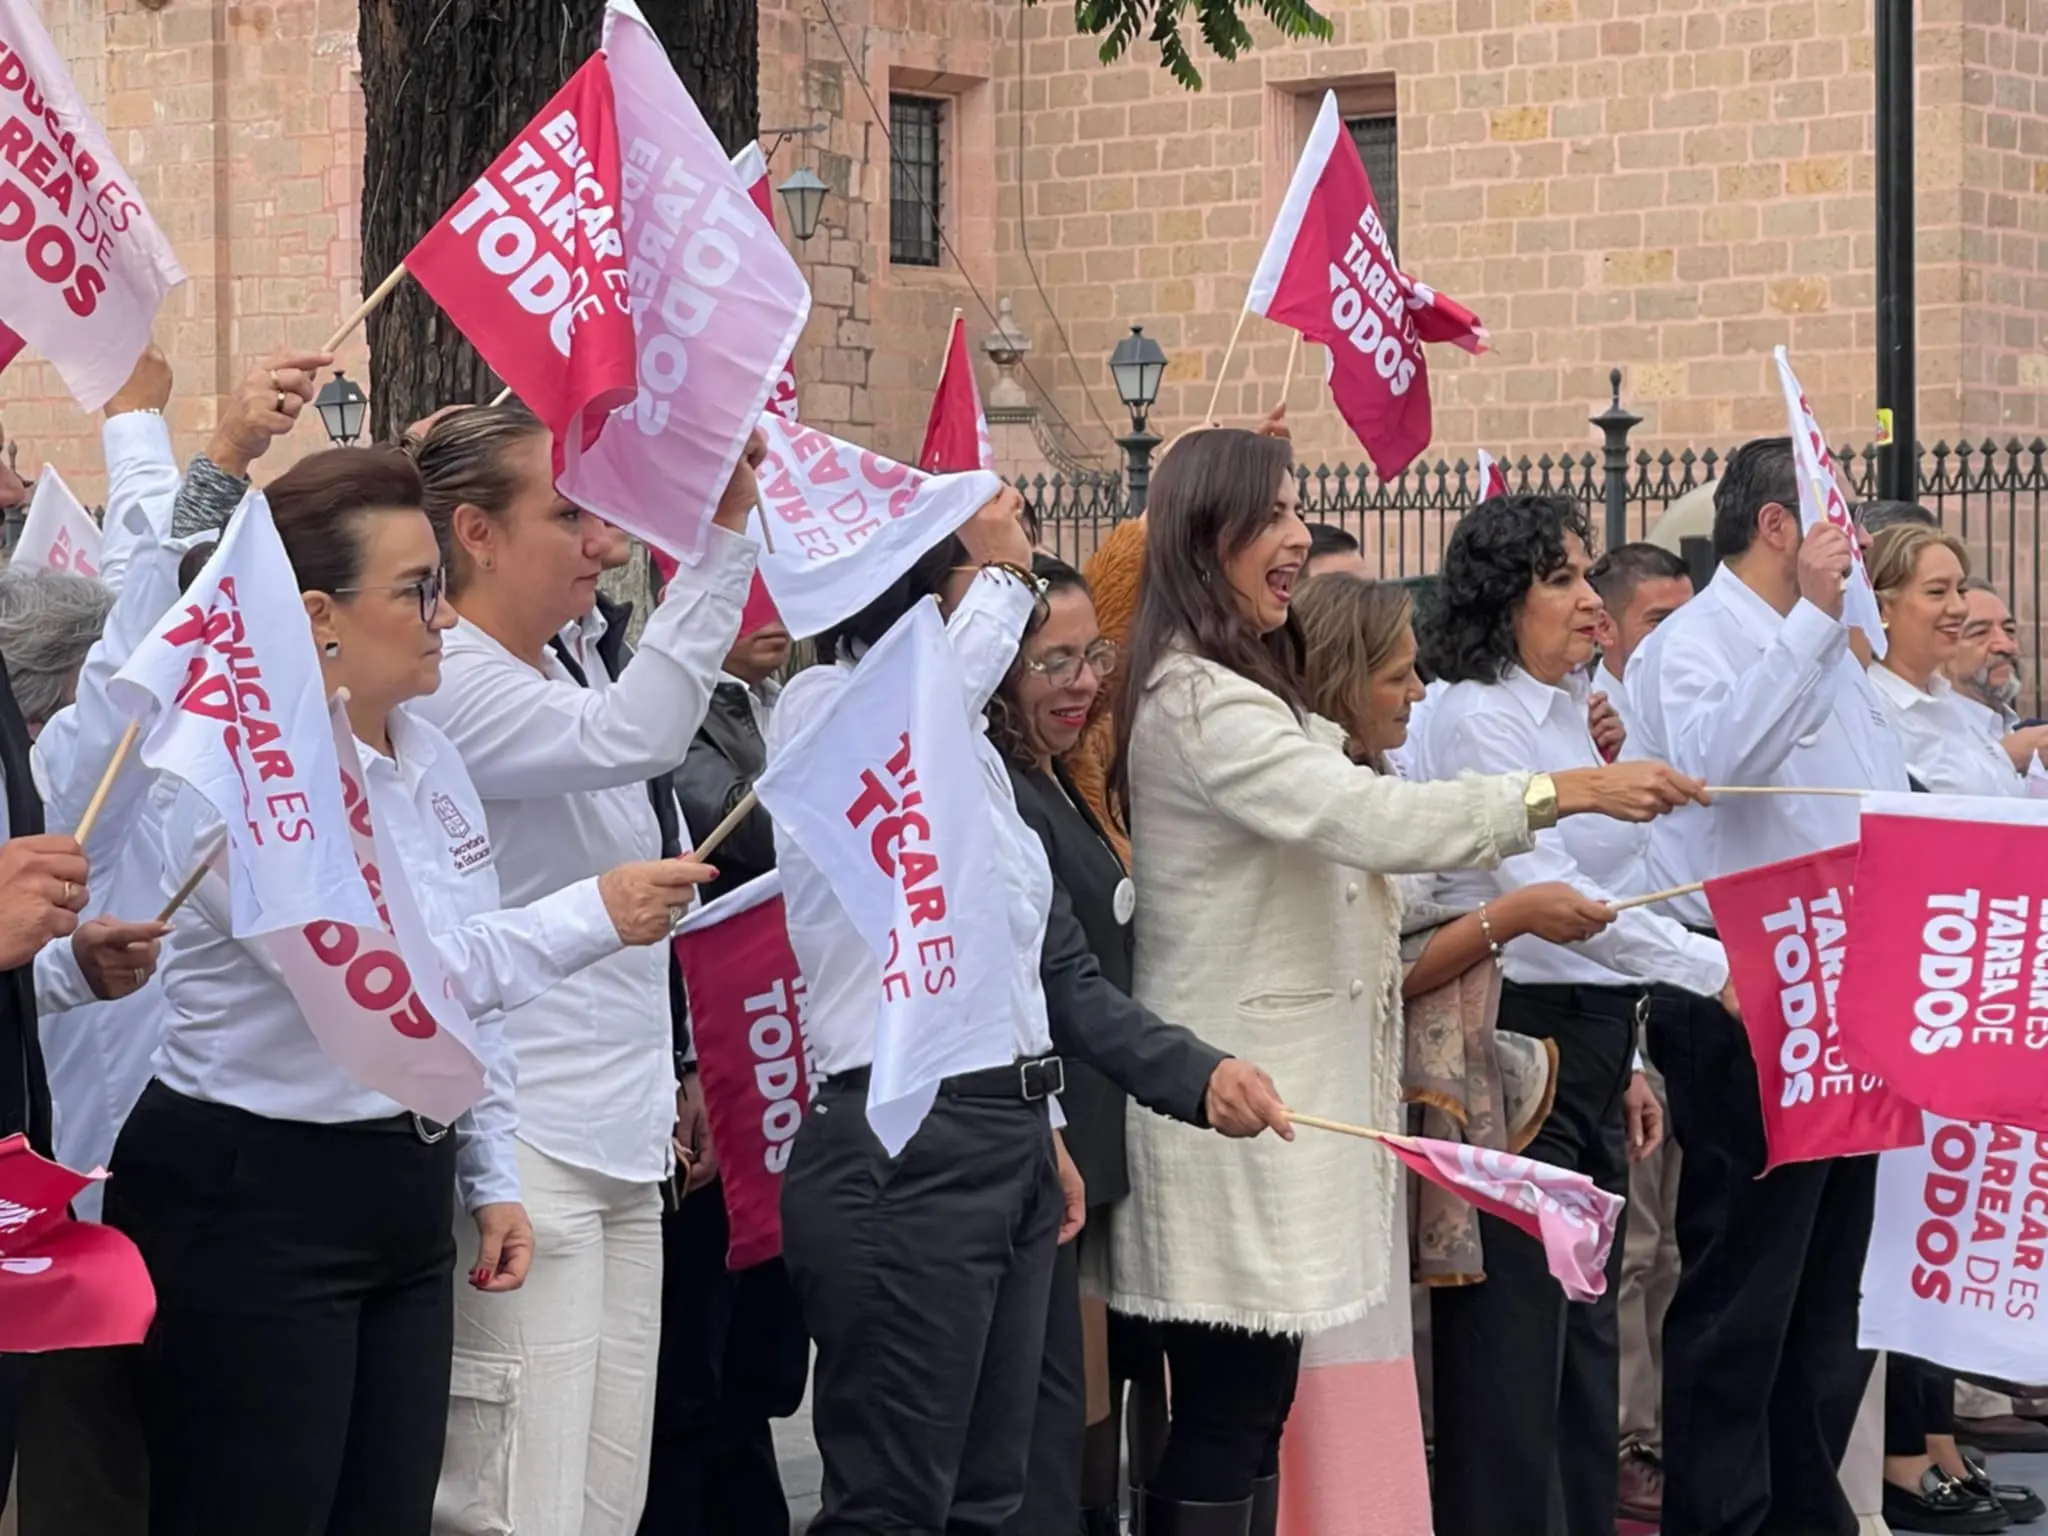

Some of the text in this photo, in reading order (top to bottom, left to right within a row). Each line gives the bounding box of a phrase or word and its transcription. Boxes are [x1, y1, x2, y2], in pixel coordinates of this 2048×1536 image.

[0, 41, 141, 232] DUCAR ES
[0, 115, 114, 272] REA DE
[0, 178, 106, 318] DOS
[1343, 231, 1405, 331] TAREA
[1329, 261, 1417, 397] TODOS
[265, 791, 316, 843] ES
[302, 919, 438, 1040] DOS
[917, 933, 956, 996] ES
[1761, 896, 1821, 1108] TODOS
[1909, 888, 1981, 1056] TODOS
[1971, 895, 2030, 1046] TAREA DE
[743, 977, 802, 1175] TODOS
[1910, 1120, 1977, 1305] ODOS
[1959, 1122, 2023, 1311] AREA DE
[2004, 1278, 2039, 1321] ES
